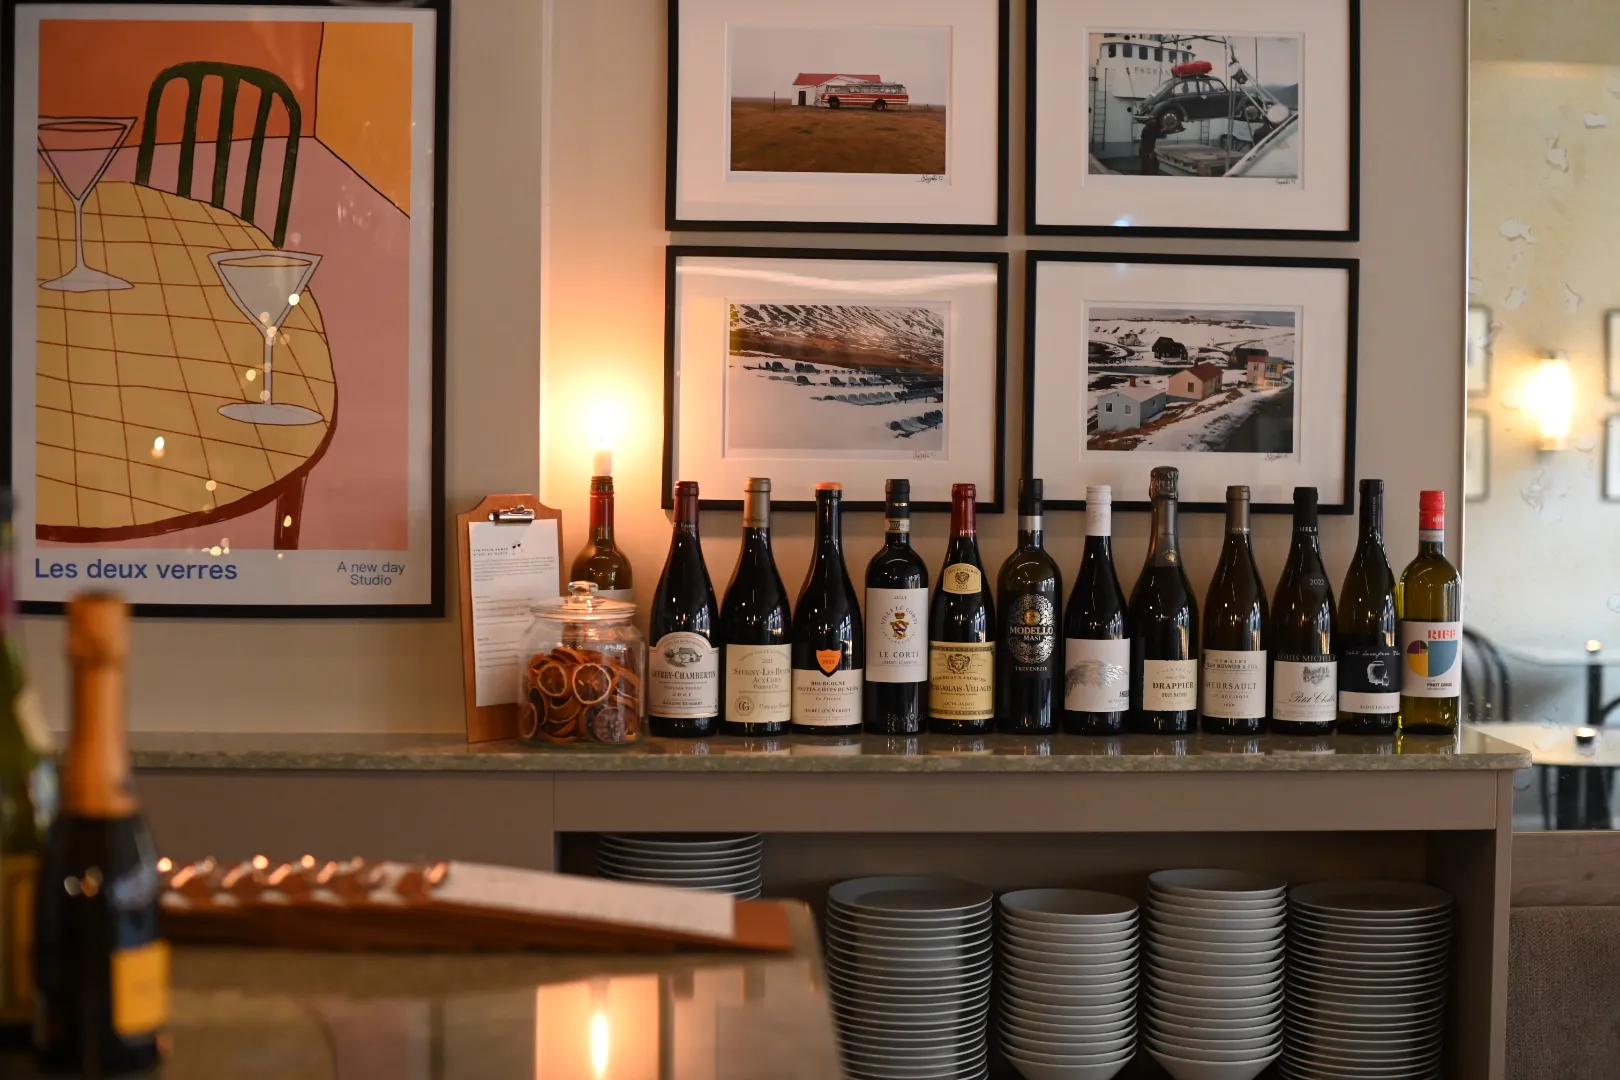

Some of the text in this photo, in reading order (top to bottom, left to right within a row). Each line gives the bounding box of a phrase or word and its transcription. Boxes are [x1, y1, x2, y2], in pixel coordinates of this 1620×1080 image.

[35, 558, 238, 579] Les deux verres
[337, 561, 406, 576] A new day
[350, 573, 392, 586] Studio
[1010, 626, 1054, 635] MODELLO
[1428, 629, 1456, 640] RIFF
[879, 651, 919, 659] LE CORTI
[1152, 681, 1194, 689] DRAPPIER
[1289, 691, 1312, 703] Petit
